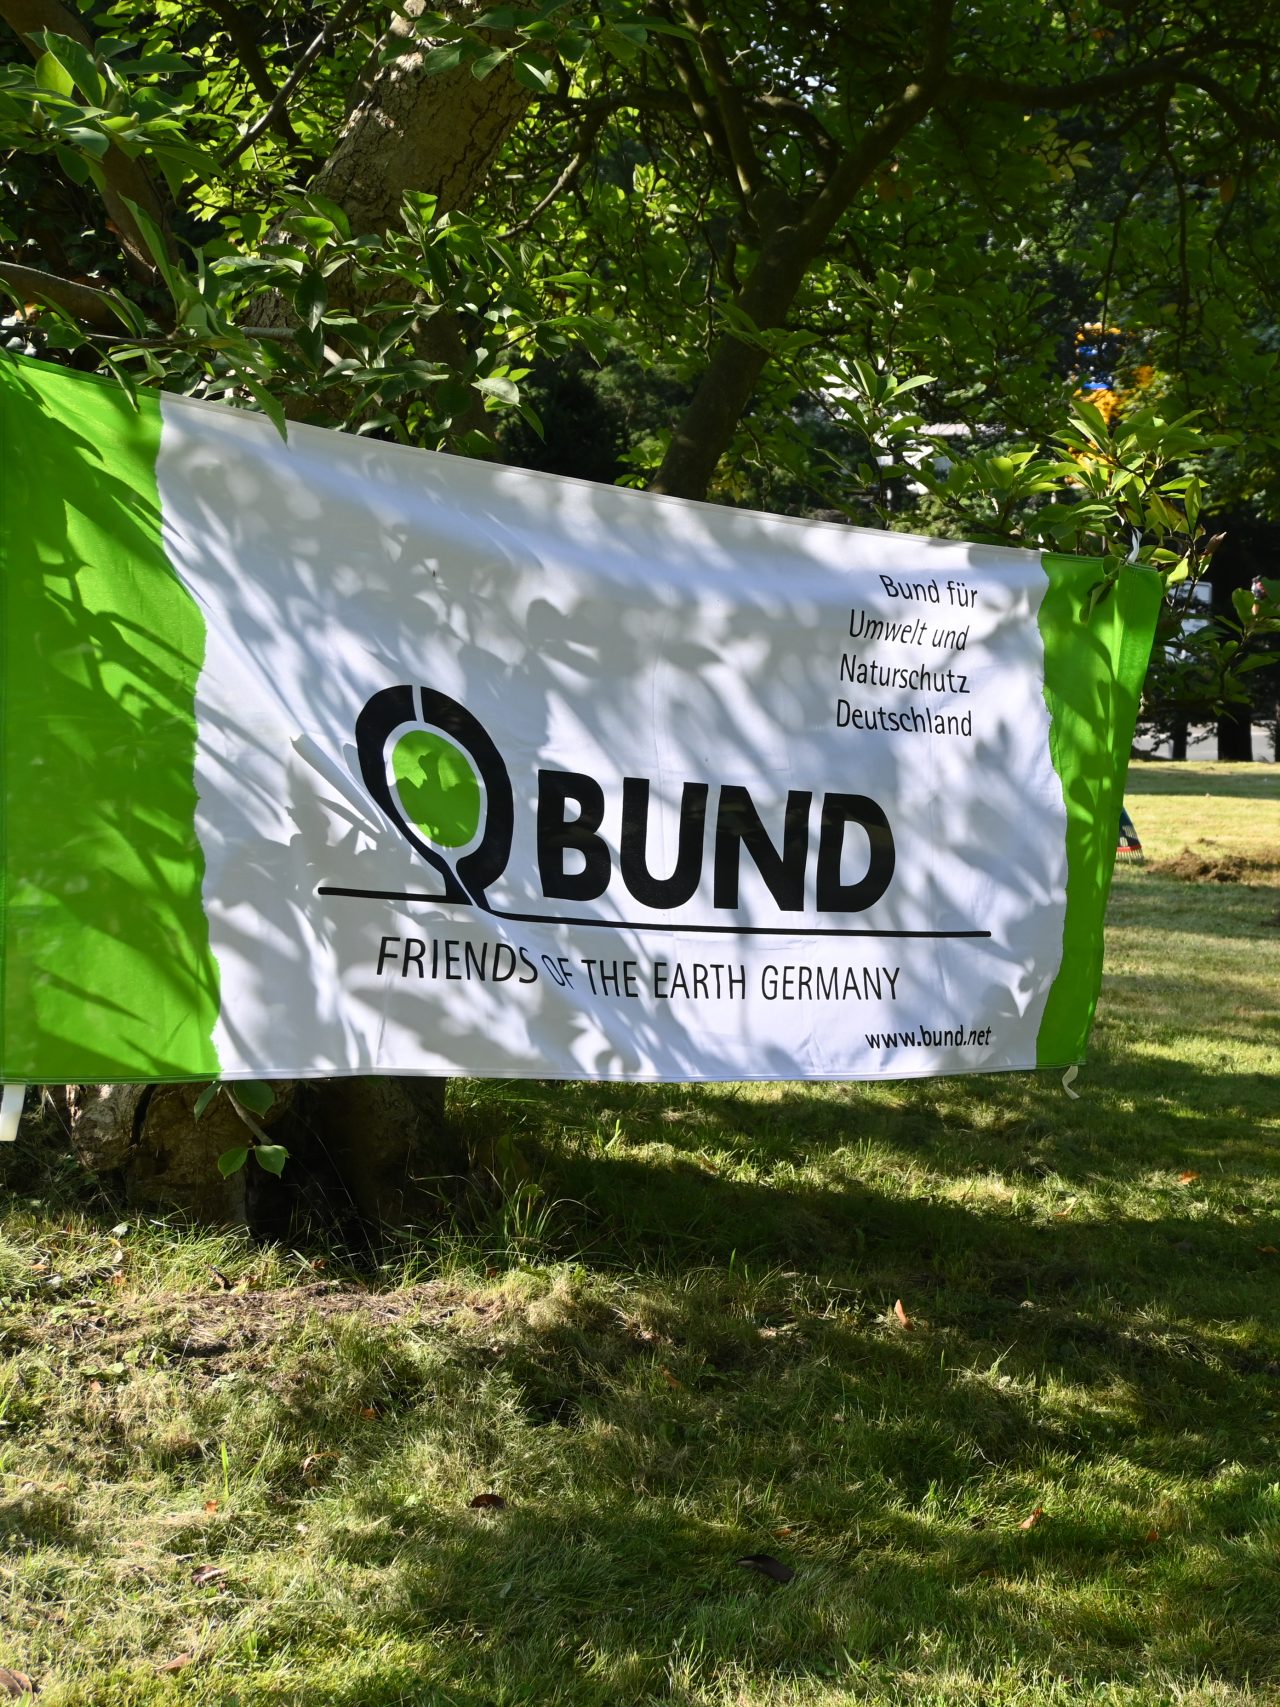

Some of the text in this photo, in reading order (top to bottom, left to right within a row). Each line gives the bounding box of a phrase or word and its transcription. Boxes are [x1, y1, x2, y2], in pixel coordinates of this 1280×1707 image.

[879, 574, 978, 608] Bund für
[849, 608, 970, 651] Umwelt und
[839, 653, 971, 694] Naturschutz
[836, 698, 973, 737] Deutschland
[535, 768, 896, 914] BUND
[376, 936, 901, 1000] FRIENDS OF THE EARTH GERMANY
[865, 1024, 992, 1050] www.bund.net
